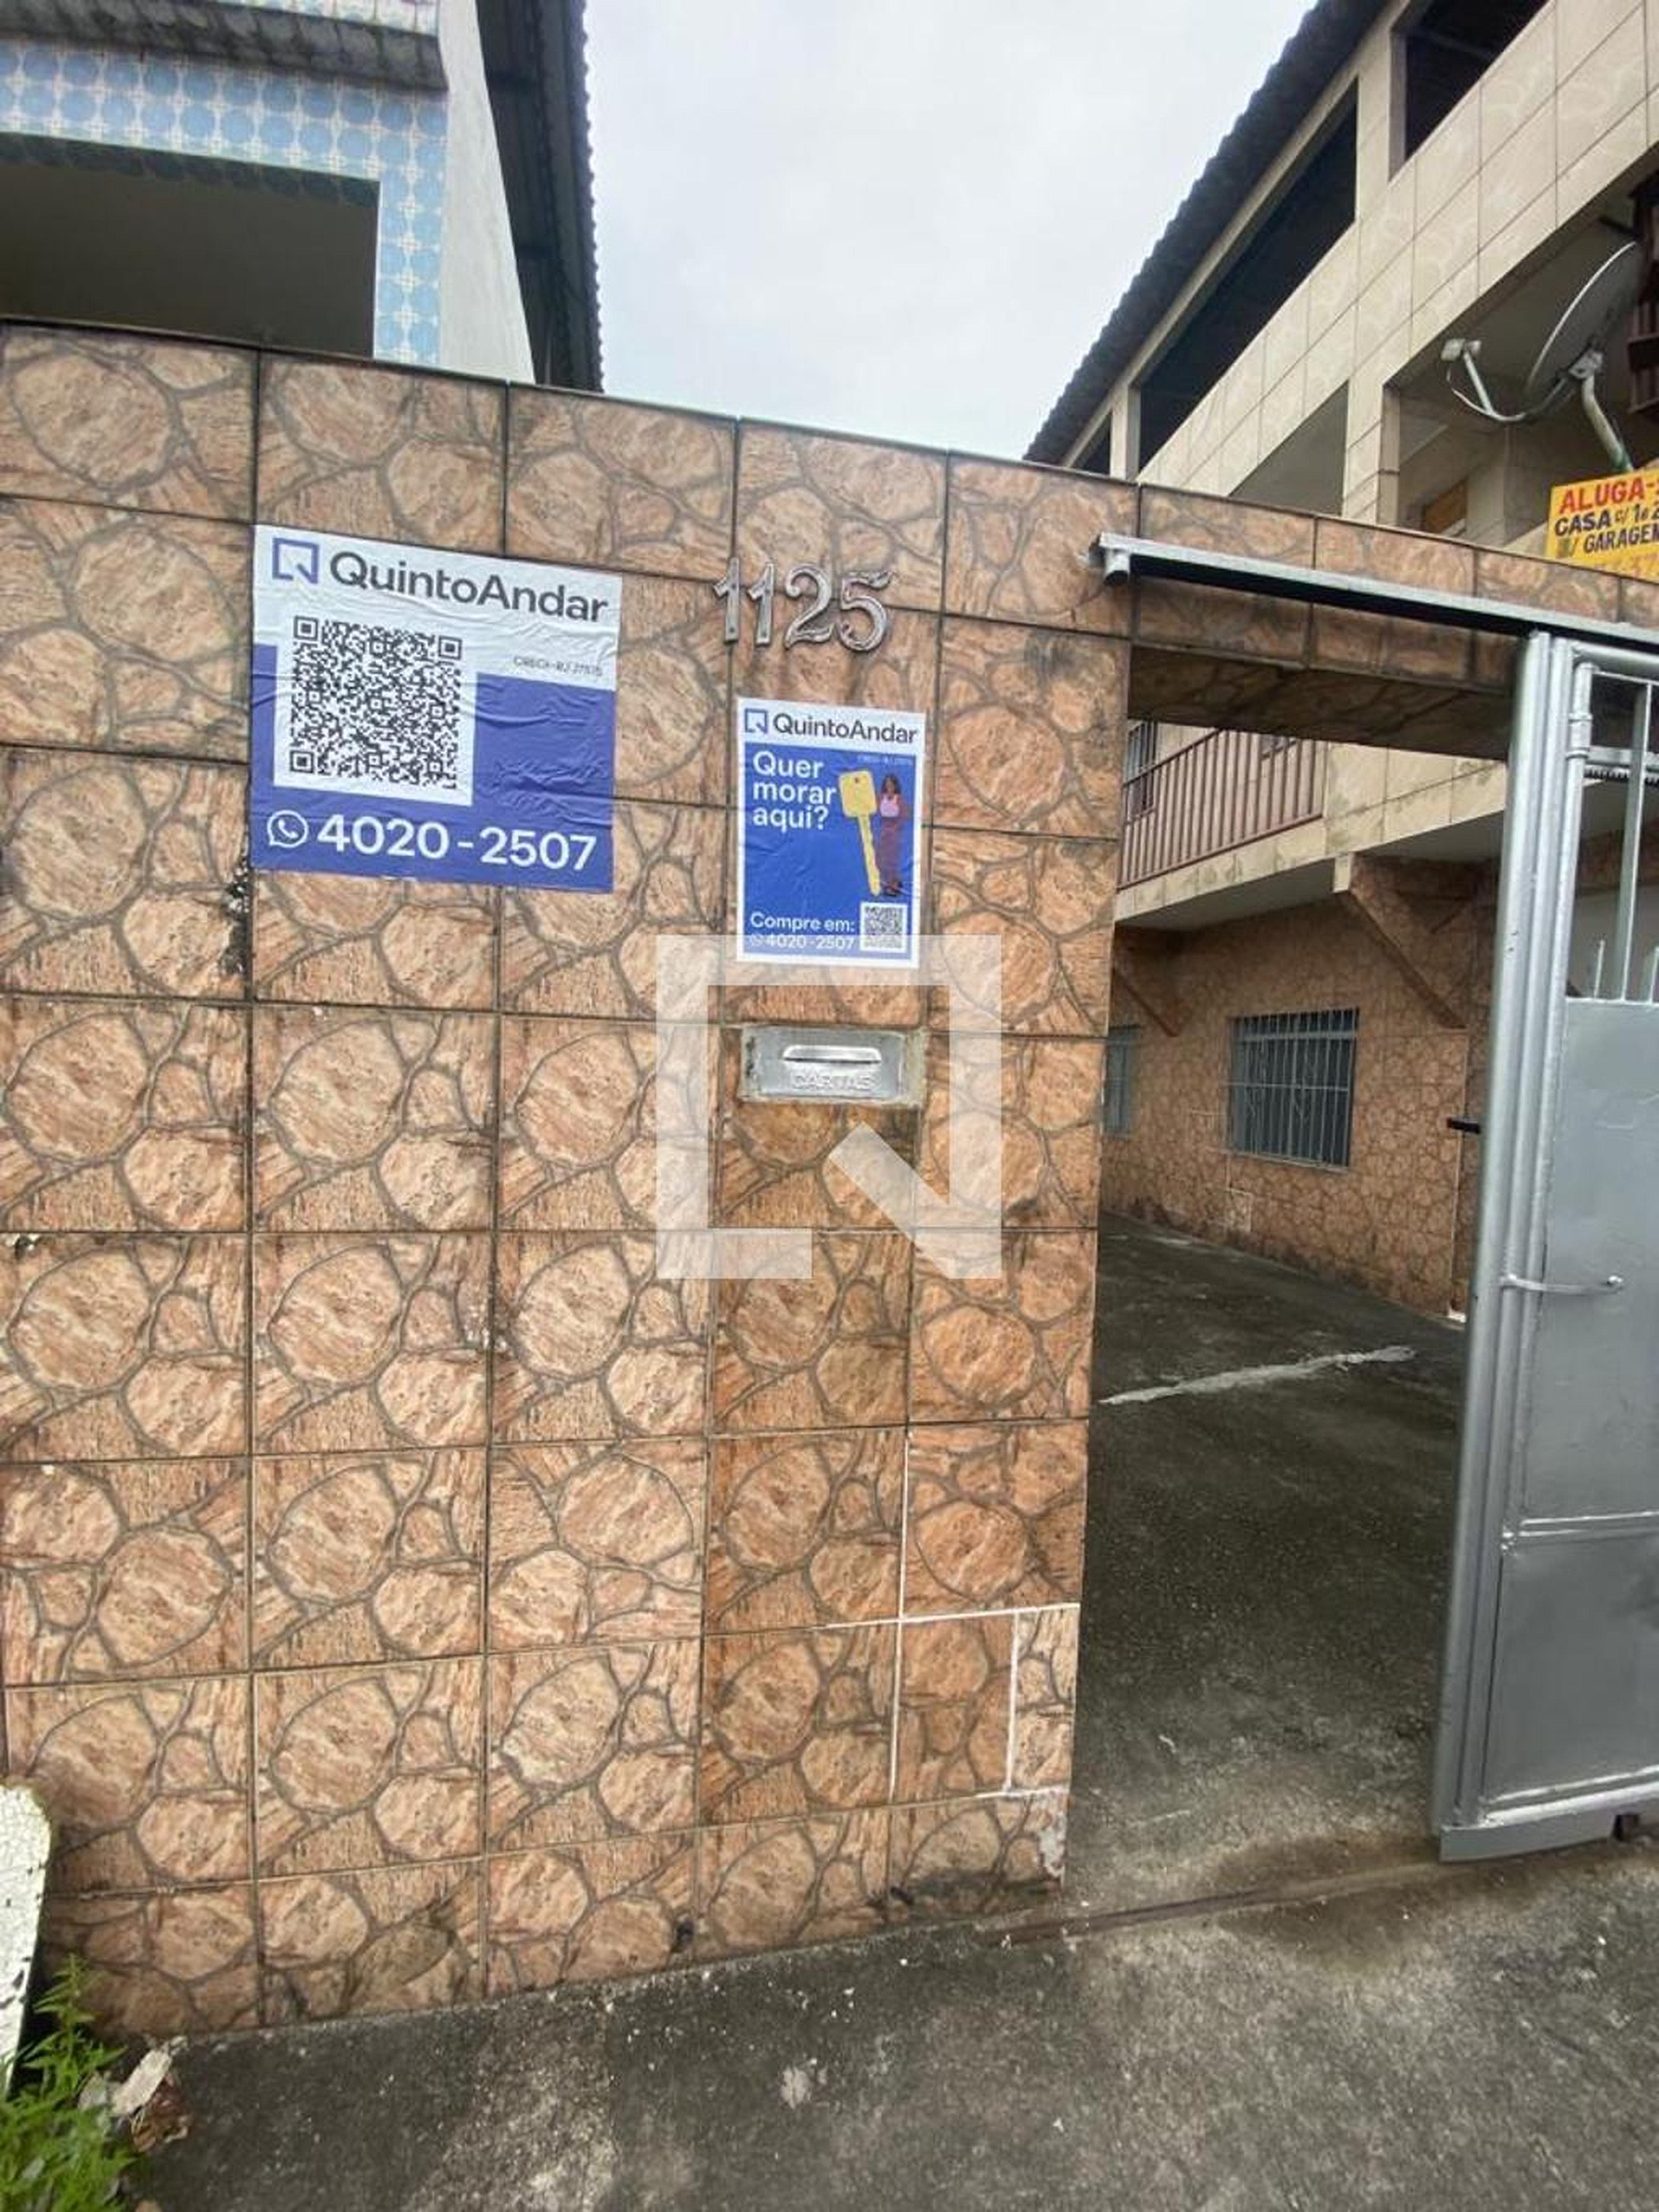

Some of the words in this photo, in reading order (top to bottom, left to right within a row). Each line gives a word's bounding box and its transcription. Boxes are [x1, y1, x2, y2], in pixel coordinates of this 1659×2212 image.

[1560, 477, 1659, 514] ALUGA-
[1555, 509, 1611, 536] CASA
[330, 551, 608, 622] QuintoAndar
[712, 556, 895, 652] 1125
[773, 713, 918, 743] QuintoAndar
[753, 751, 823, 778] Quer
[753, 781, 836, 805] morar
[753, 805, 829, 833] aqui?
[750, 912, 821, 932] Compre
[824, 918, 855, 933] em:
